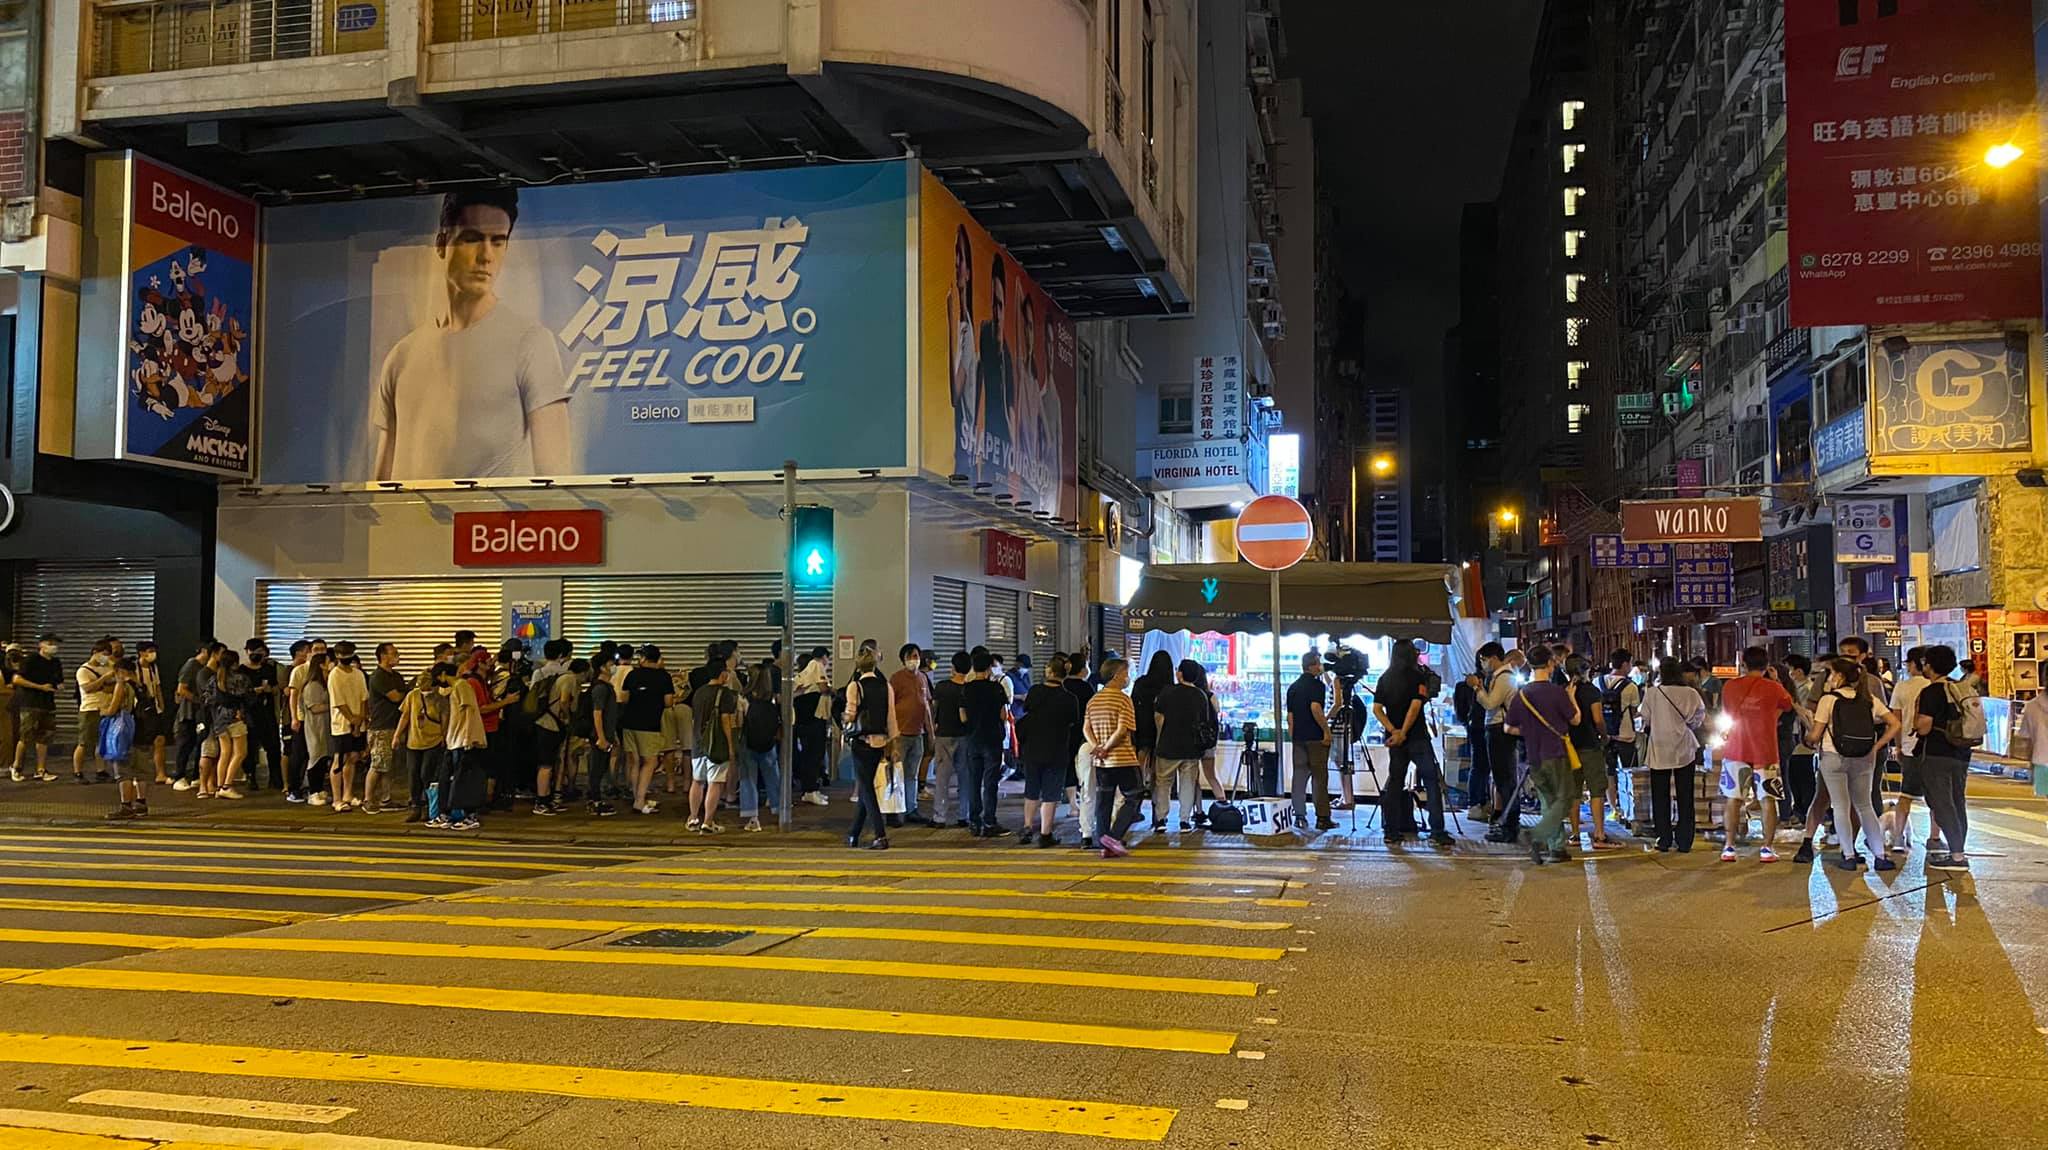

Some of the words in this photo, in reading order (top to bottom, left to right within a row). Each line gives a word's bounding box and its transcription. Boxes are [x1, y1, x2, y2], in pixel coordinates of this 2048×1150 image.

[1835, 45, 1887, 77] EF
[1891, 75, 1939, 89] English
[1943, 72, 1995, 84] Centers
[1813, 108, 2012, 143] 旺角英語培訓中
[152, 181, 239, 240] Baleno
[1821, 252, 1862, 268] 6278
[1868, 249, 1910, 265] 2299
[1951, 244, 1994, 260] 2396
[1999, 242, 2042, 257] 4989
[1799, 269, 1846, 280] WhatsApp
[564, 348, 670, 392] FEEL
[684, 343, 804, 384] COOL
[631, 404, 681, 419] Baleno
[186, 434, 248, 461] MICKEY
[960, 420, 1001, 465] SHAPE
[1154, 448, 1199, 460] FLORIDA
[1204, 446, 1239, 458] HOTEL
[193, 454, 209, 463] AND
[211, 457, 241, 469] FRIENDS
[1154, 467, 1201, 479] VIRGINIA
[1205, 465, 1240, 477] HOTEL
[1655, 505, 1727, 534] wanko
[471, 519, 580, 552] Baleno
[997, 541, 1023, 570] Baleno
